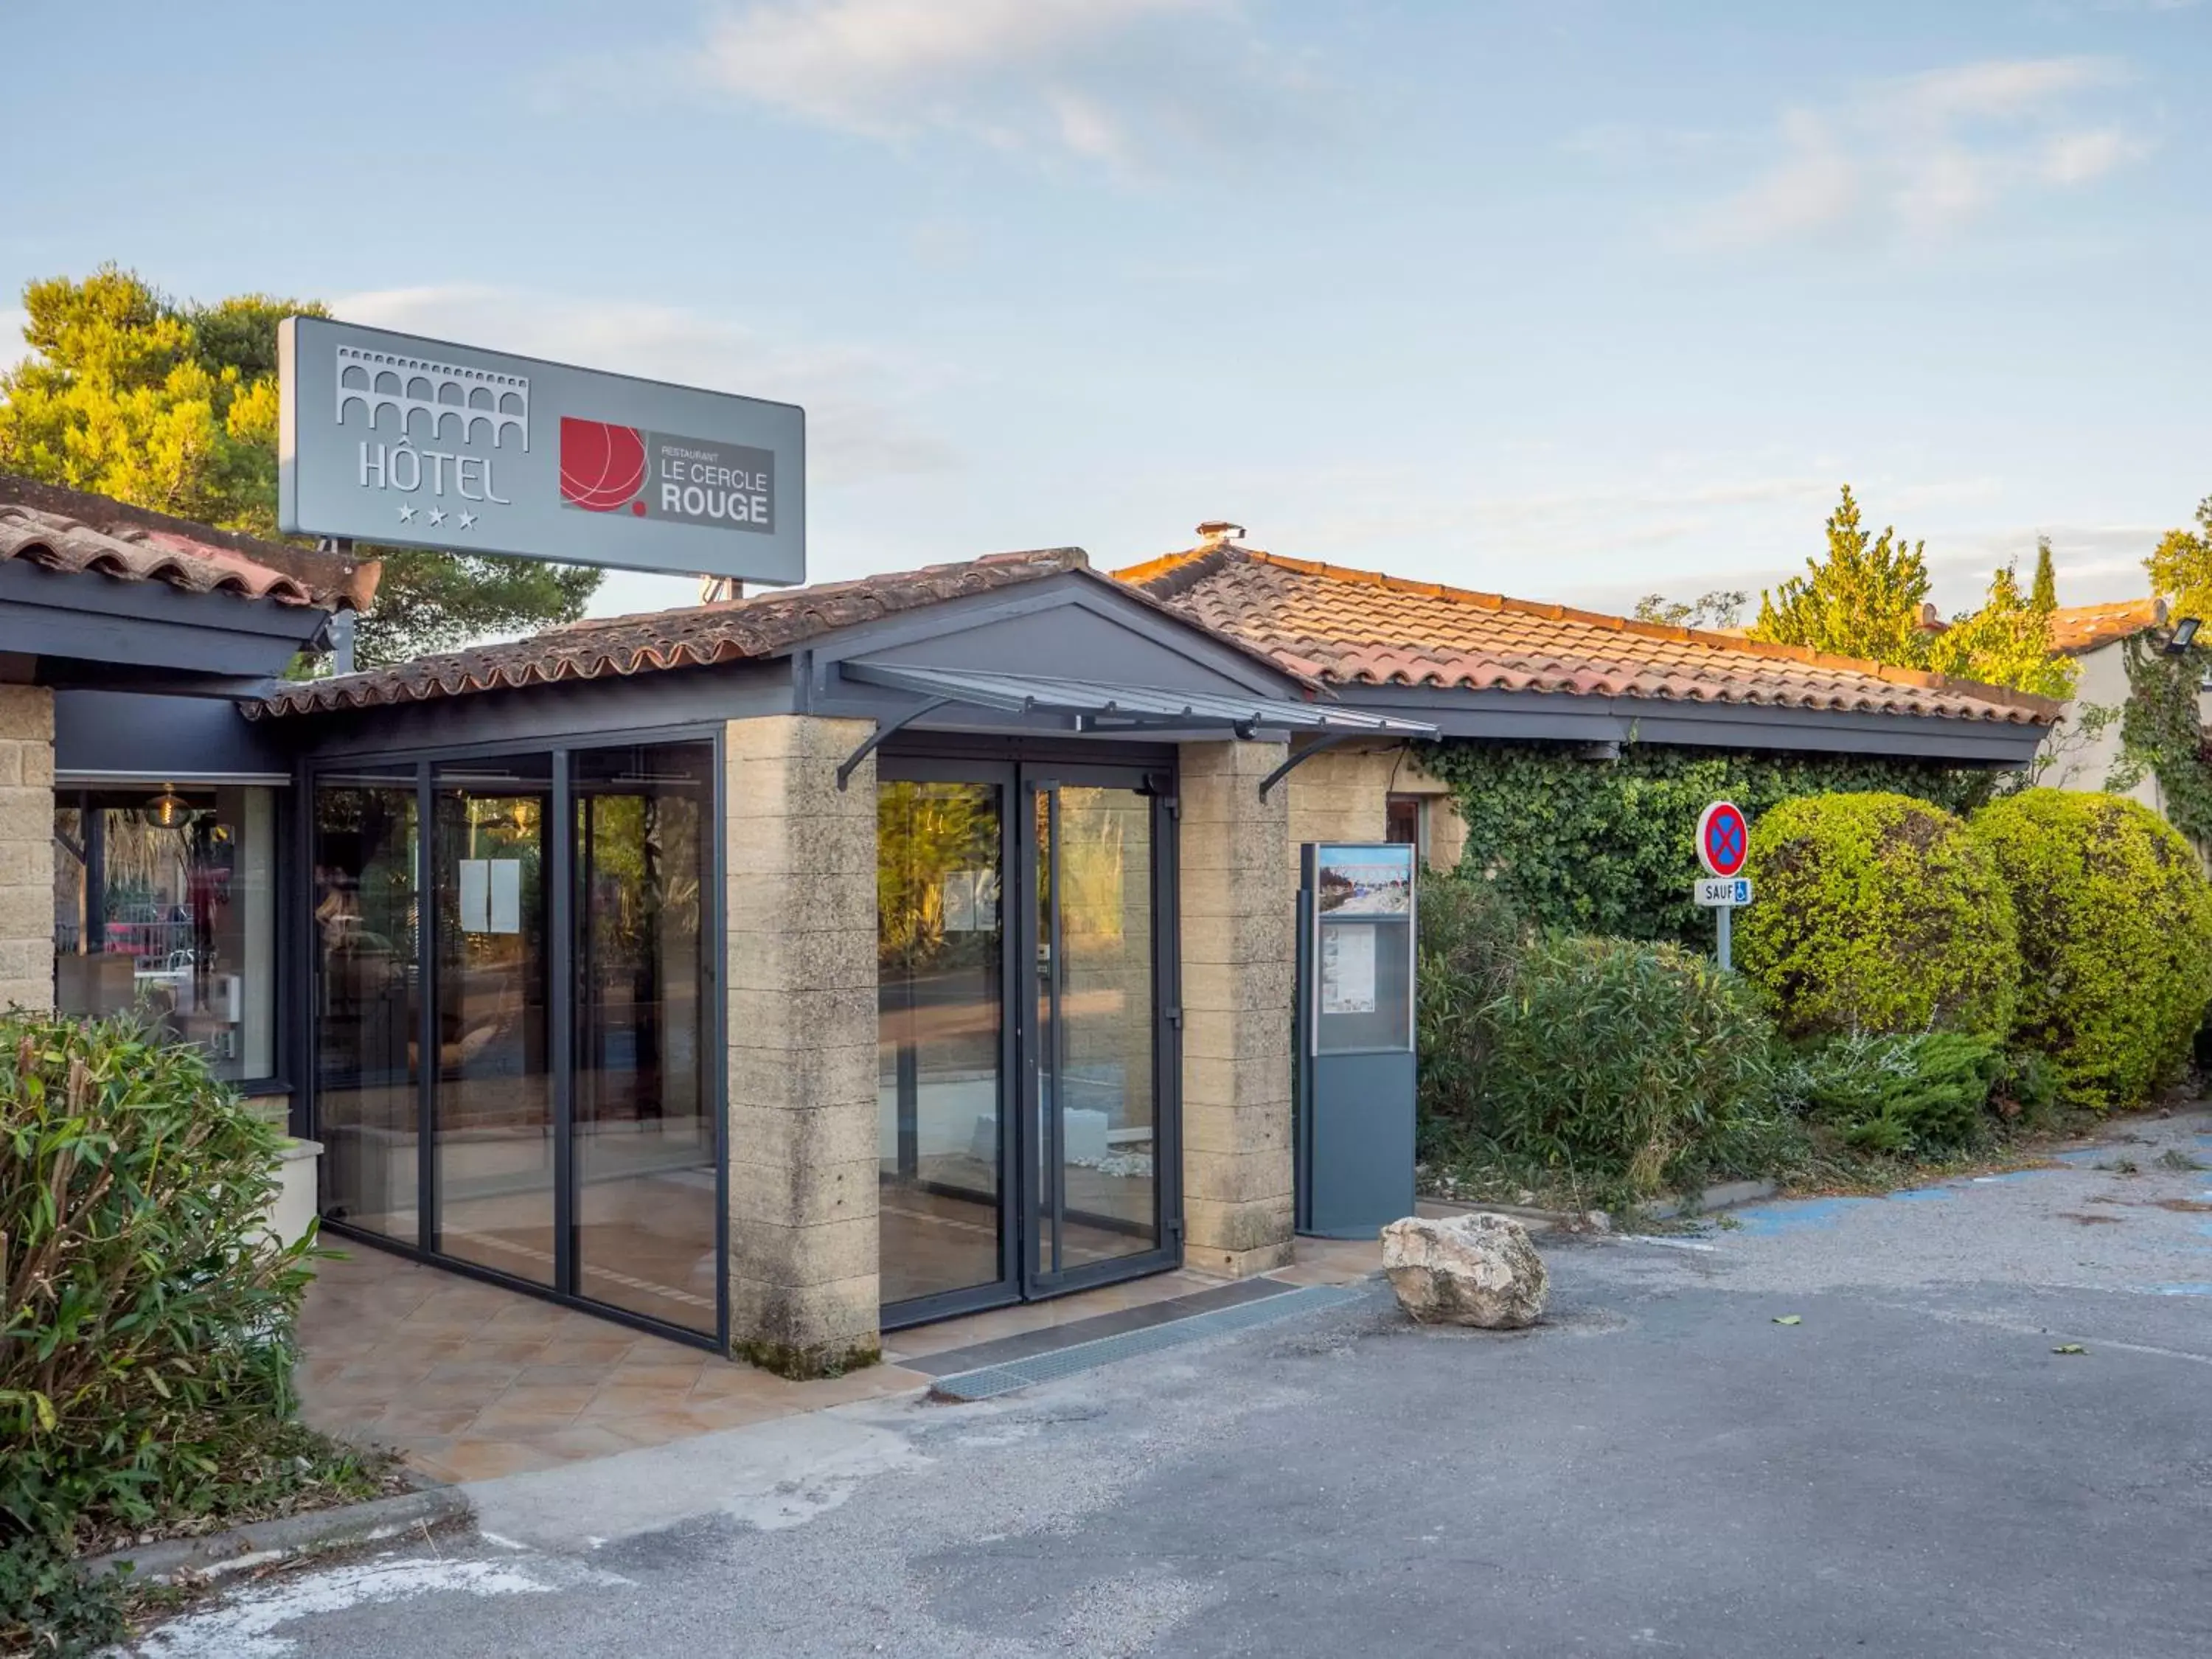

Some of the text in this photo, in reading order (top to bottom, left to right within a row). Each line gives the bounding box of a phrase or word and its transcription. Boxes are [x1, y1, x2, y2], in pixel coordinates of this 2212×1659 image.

[359, 434, 511, 504] HÔTEL
[661, 446, 719, 462] RESTAURANT
[661, 459, 768, 492] LE CERCLE
[661, 482, 768, 524] ROUGE
[1705, 885, 1733, 900] SAUF
